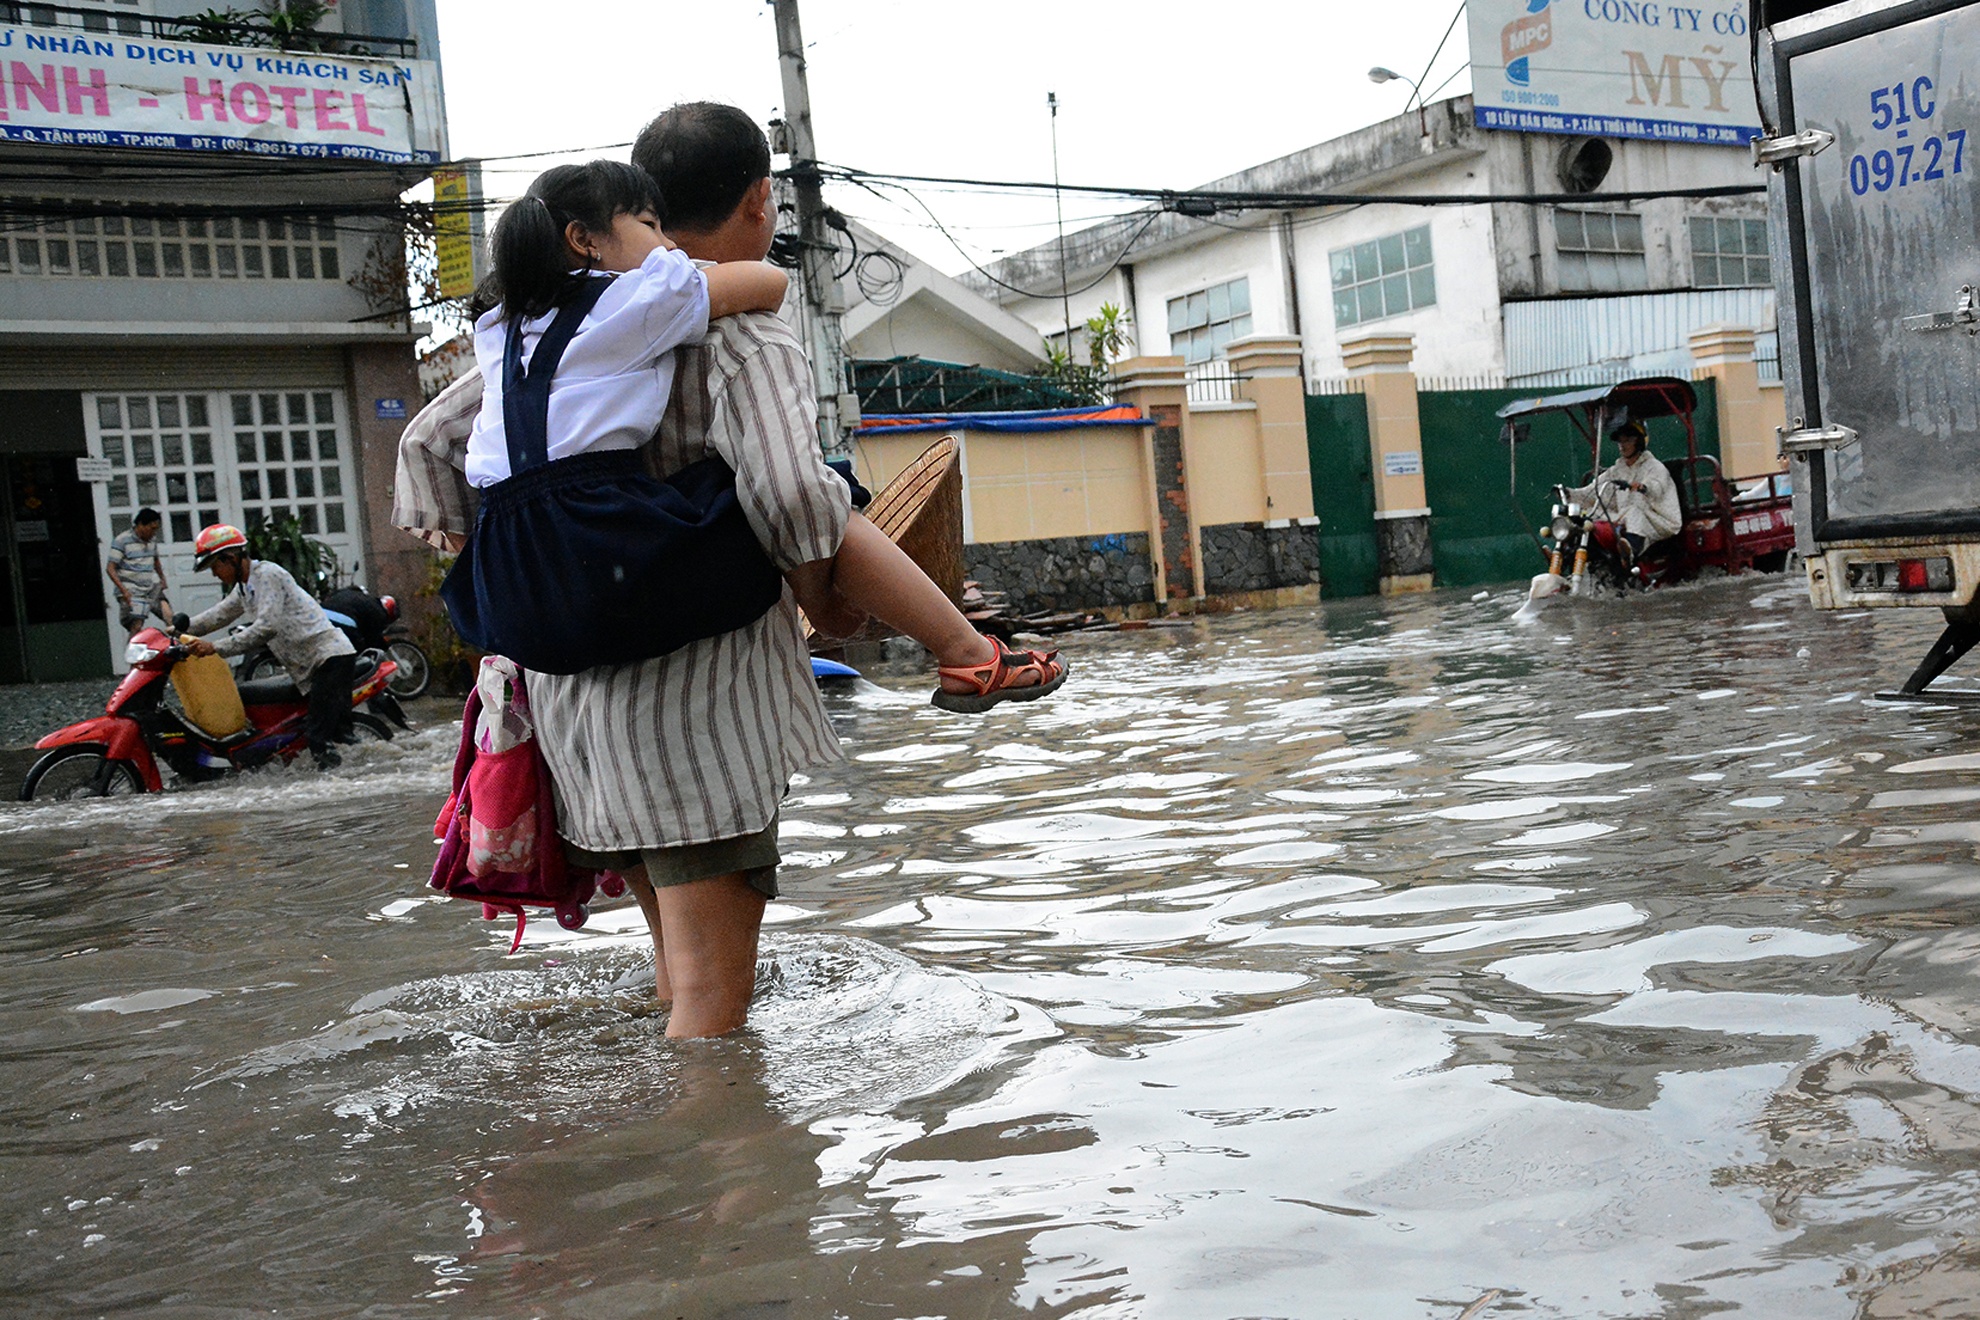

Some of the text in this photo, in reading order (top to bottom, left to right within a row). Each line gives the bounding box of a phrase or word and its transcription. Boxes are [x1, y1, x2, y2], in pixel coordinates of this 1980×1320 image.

[1509, 23, 1549, 51] MPC
[1668, 6, 1702, 31] TY
[1713, 2, 1746, 36] CỔ
[26, 34, 114, 57] NHÂN
[126, 44, 196, 65] DỊCH
[207, 52, 243, 72] VỤ
[256, 58, 348, 81] KHÁCH
[359, 67, 412, 88] SẠN
[1622, 44, 1737, 112] MỸ
[183, 77, 385, 137] HOTEL
[1501, 89, 1559, 106] ISO 9001:2000
[1870, 75, 1935, 130] 51C
[22, 129, 39, 142] Q.
[41, 128, 73, 143] TÂN
[77, 130, 107, 143] PHÚ
[121, 134, 176, 147] TP.HCM
[191, 137, 217, 148] ĐT:
[253, 142, 298, 155] 39612
[301, 145, 328, 158] 674
[1850, 129, 1966, 196] 097.27
